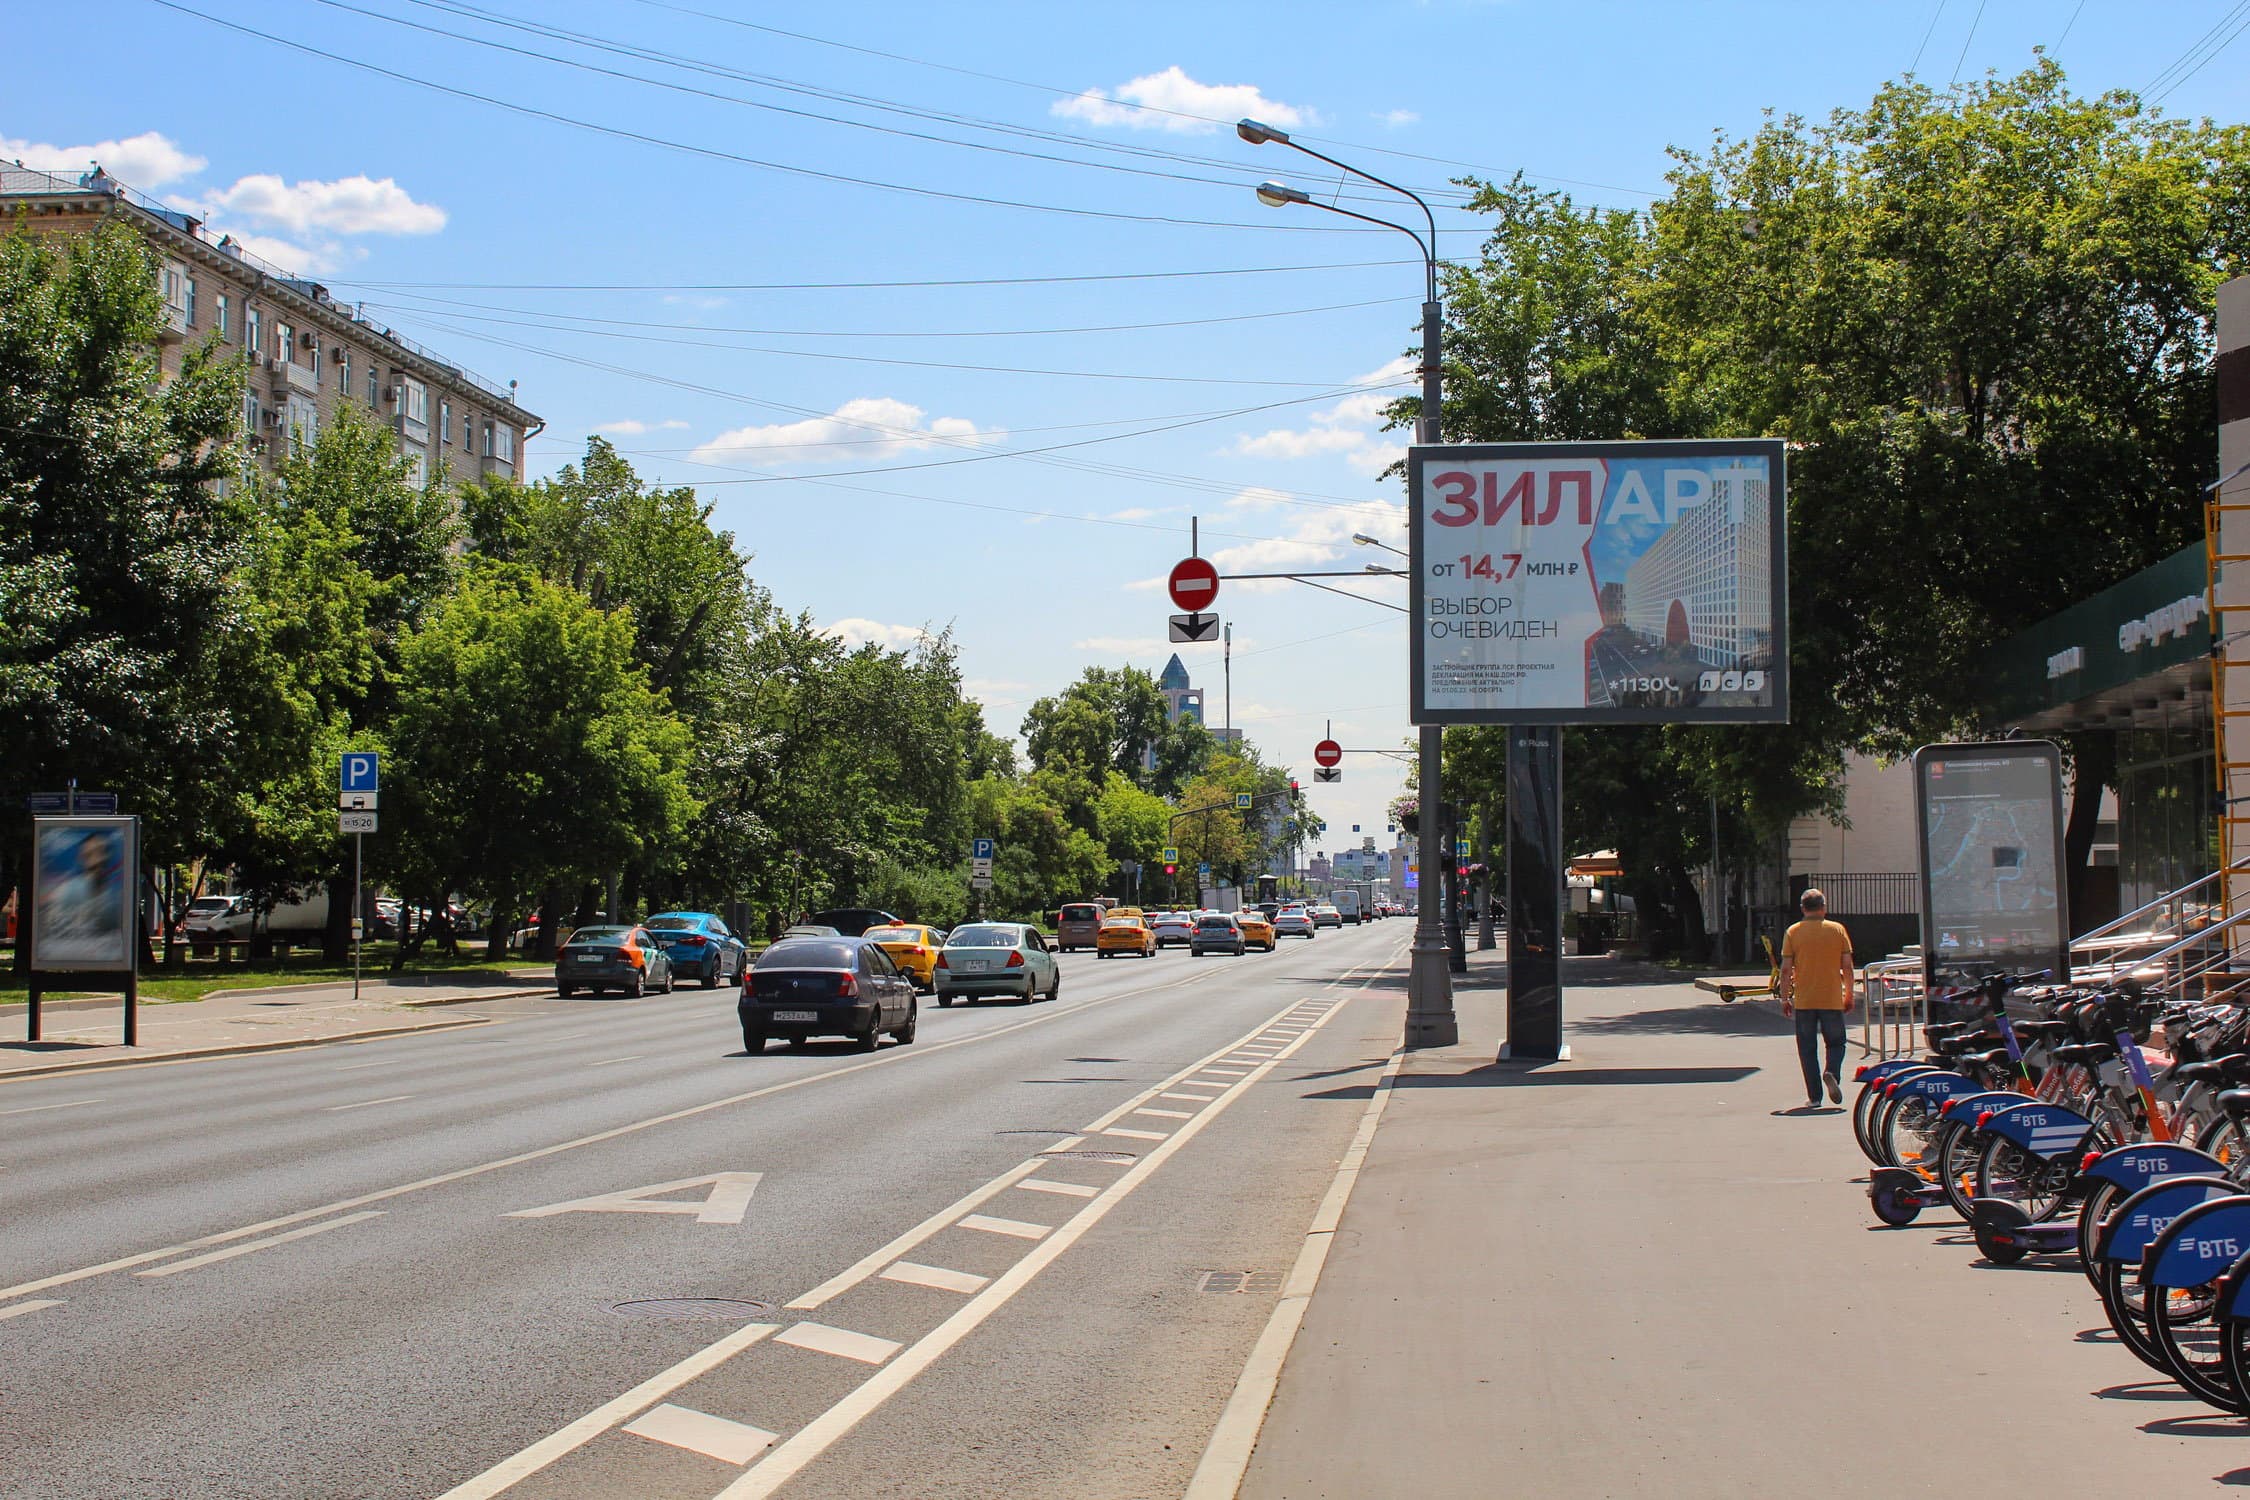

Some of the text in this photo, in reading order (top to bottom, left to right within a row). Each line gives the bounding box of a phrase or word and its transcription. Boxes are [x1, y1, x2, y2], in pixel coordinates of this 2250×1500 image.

[1459, 553, 1522, 584] 14,7
[1431, 597, 1512, 615] ВЫБОР
[1430, 620, 1558, 641] ОЧЕВИДЕН
[350, 757, 369, 787] P
[361, 819, 372, 827] 20
[978, 841, 989, 857] P
[1926, 1082, 1950, 1094] ВТБ
[2022, 1114, 2047, 1127] ВТБ
[2137, 1158, 2169, 1173] ВТБ
[2198, 1238, 2239, 1259] ВТБ
